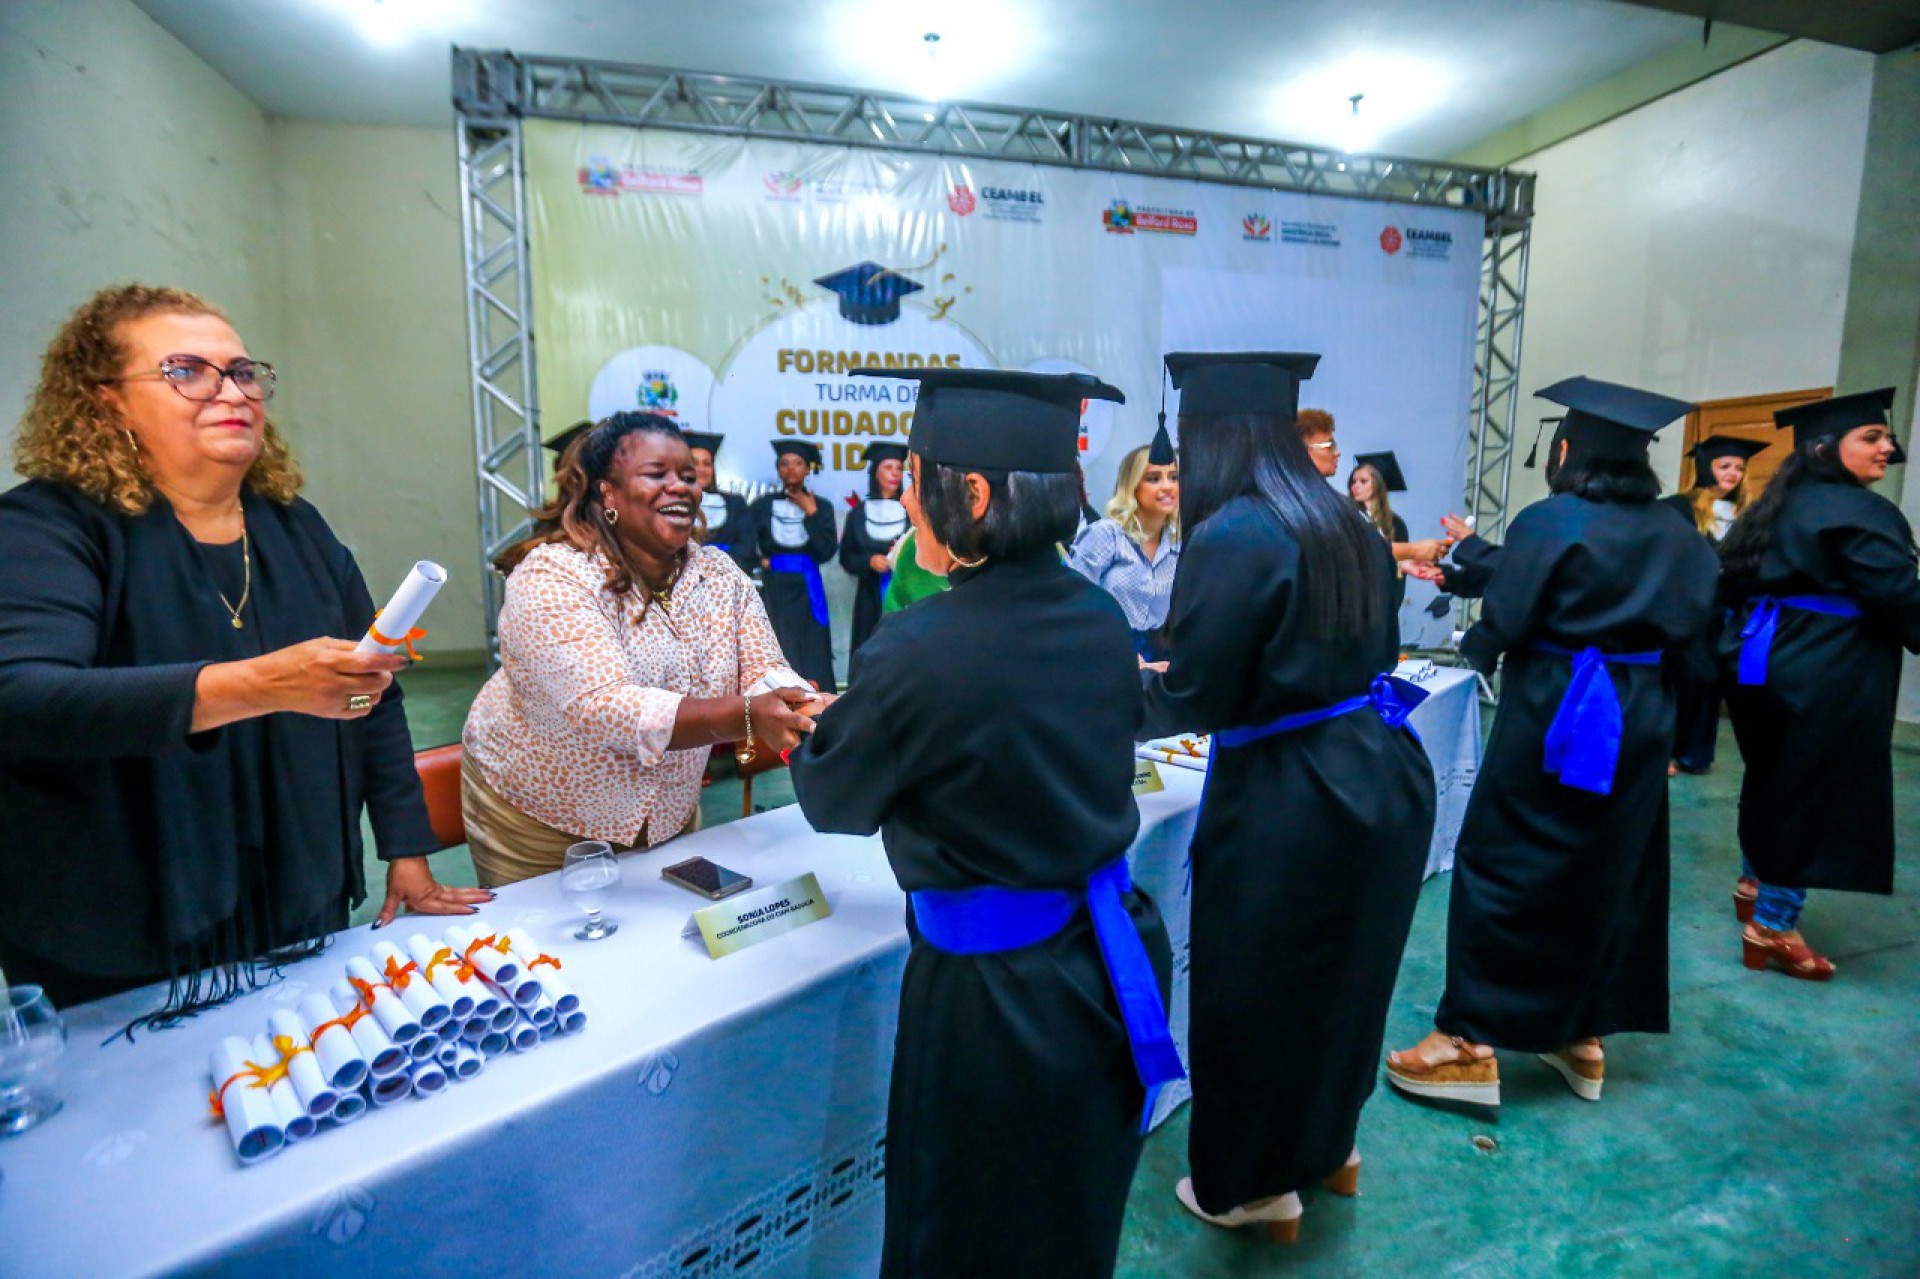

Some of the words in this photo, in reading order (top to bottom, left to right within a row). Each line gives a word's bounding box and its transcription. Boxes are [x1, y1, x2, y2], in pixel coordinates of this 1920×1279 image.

[777, 349, 961, 374] FORMANDAS
[815, 383, 892, 403] TURMA
[764, 898, 790, 914] LOPES
